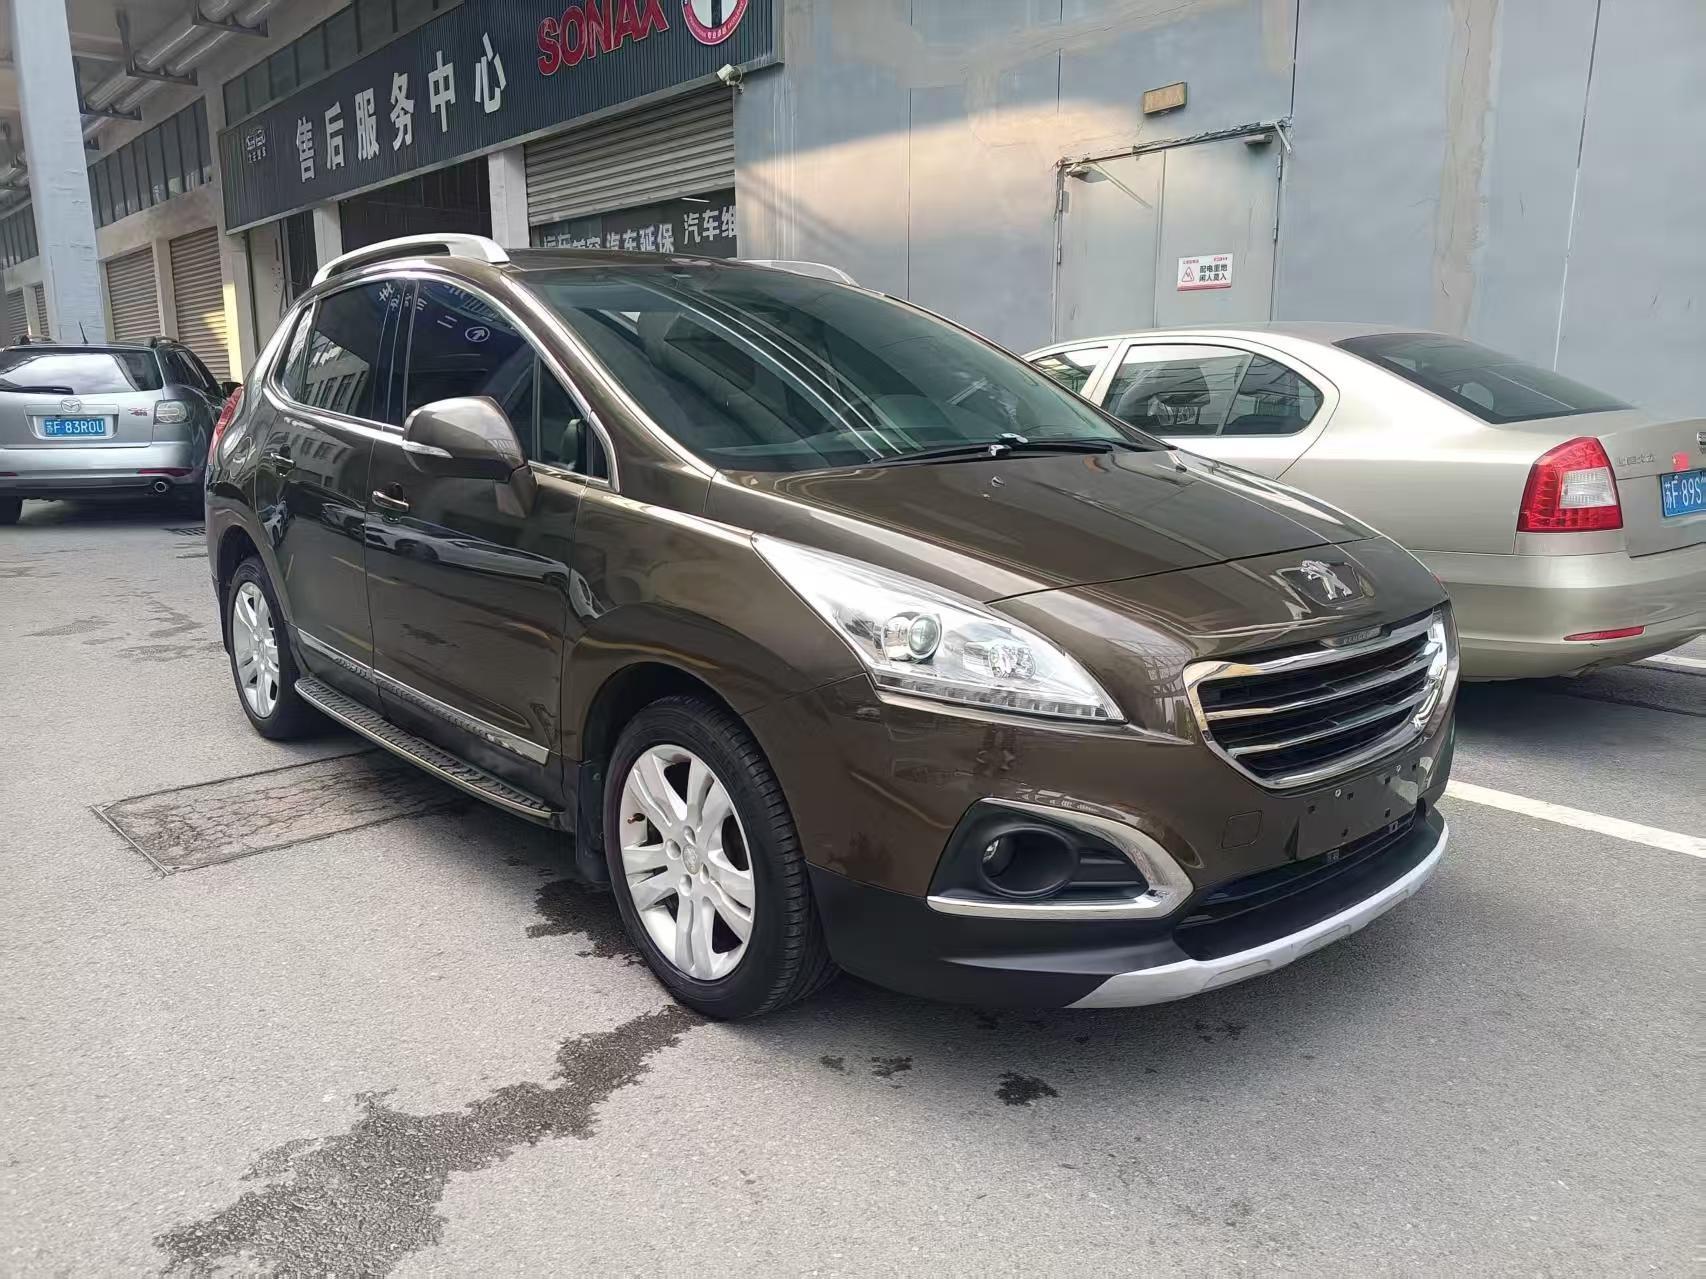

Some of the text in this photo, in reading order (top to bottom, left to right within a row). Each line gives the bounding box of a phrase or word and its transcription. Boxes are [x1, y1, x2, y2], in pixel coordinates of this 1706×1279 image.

[537, 0, 670, 76] SONAX
[296, 32, 507, 183] 售后服务中心
[1199, 273, 1226, 281] 闲人莫入
[1200, 264, 1227, 273] 配电重地
